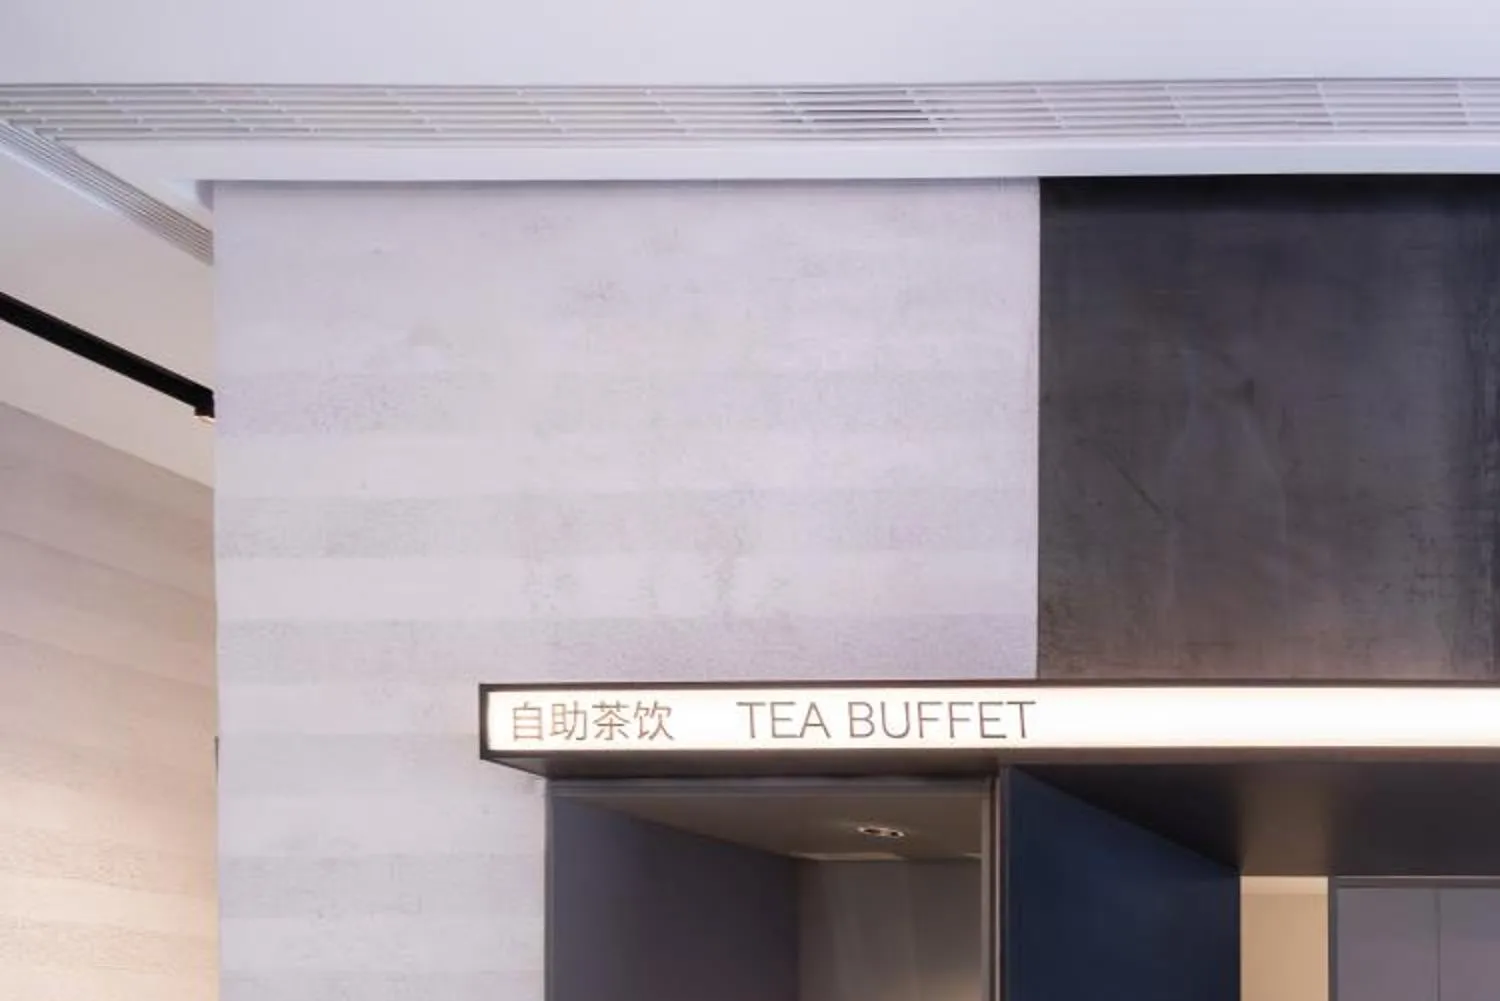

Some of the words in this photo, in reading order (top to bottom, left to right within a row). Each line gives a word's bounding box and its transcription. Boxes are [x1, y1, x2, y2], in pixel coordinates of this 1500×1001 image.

[512, 700, 673, 741] 自助茶饮
[736, 701, 832, 739] TEA
[848, 700, 1036, 739] BUFFET
